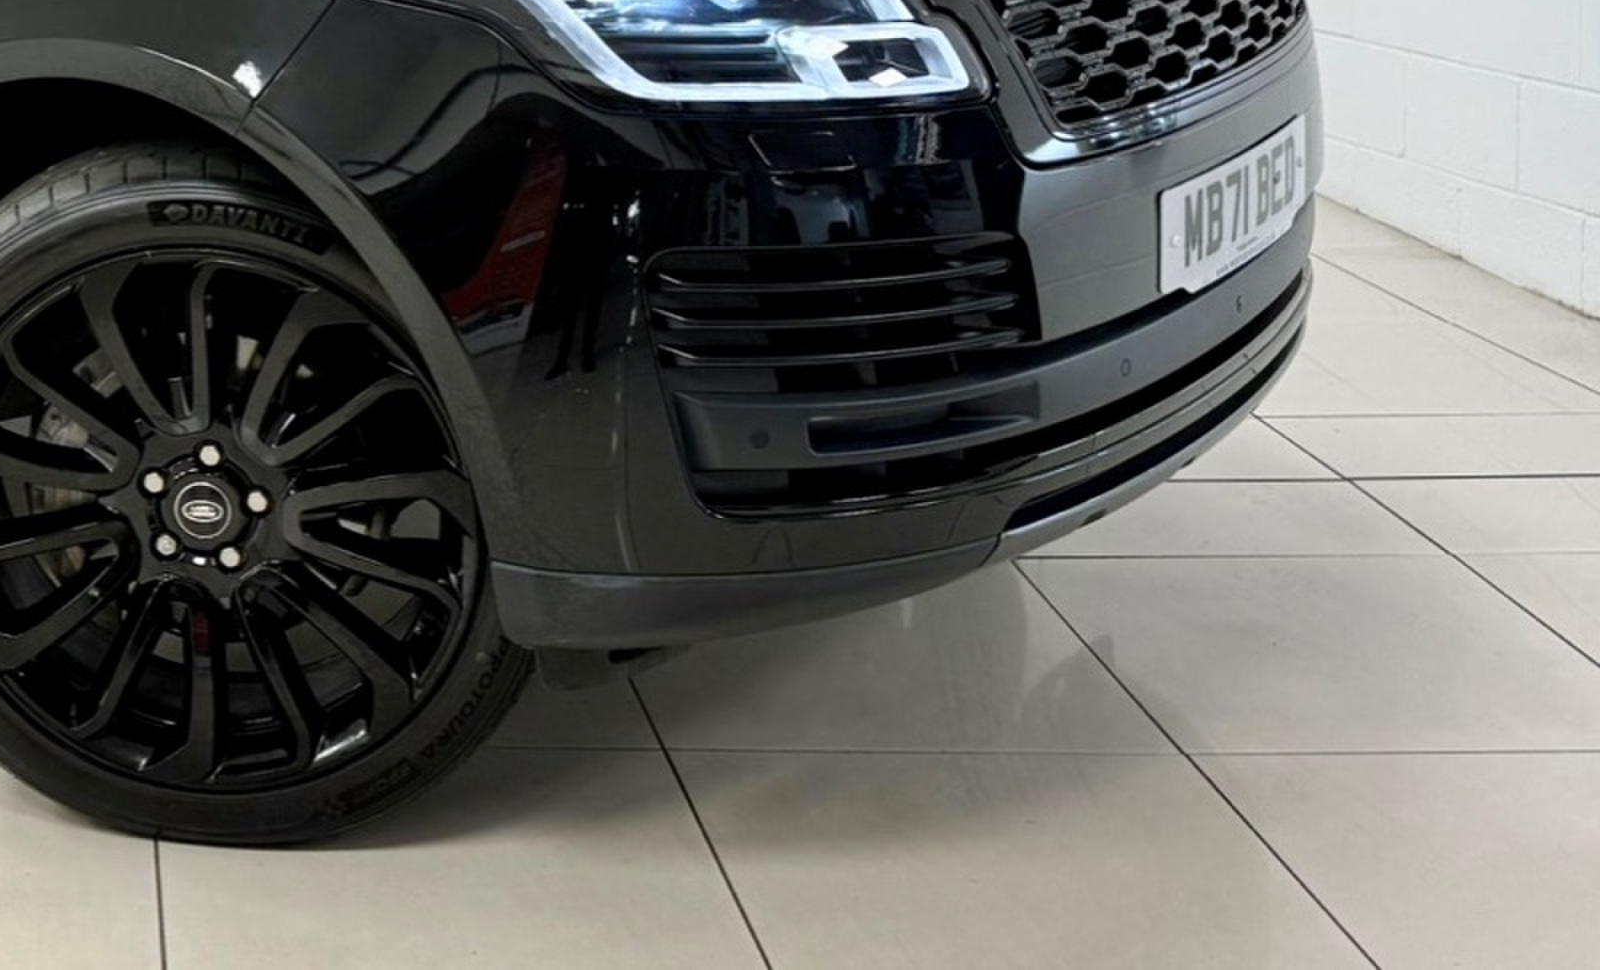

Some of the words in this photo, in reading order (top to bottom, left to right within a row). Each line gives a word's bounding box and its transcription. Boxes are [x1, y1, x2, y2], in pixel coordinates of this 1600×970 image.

[190, 202, 311, 245] DAVANTI
[1184, 164, 1249, 268] MB71
[1256, 135, 1296, 227] BED
